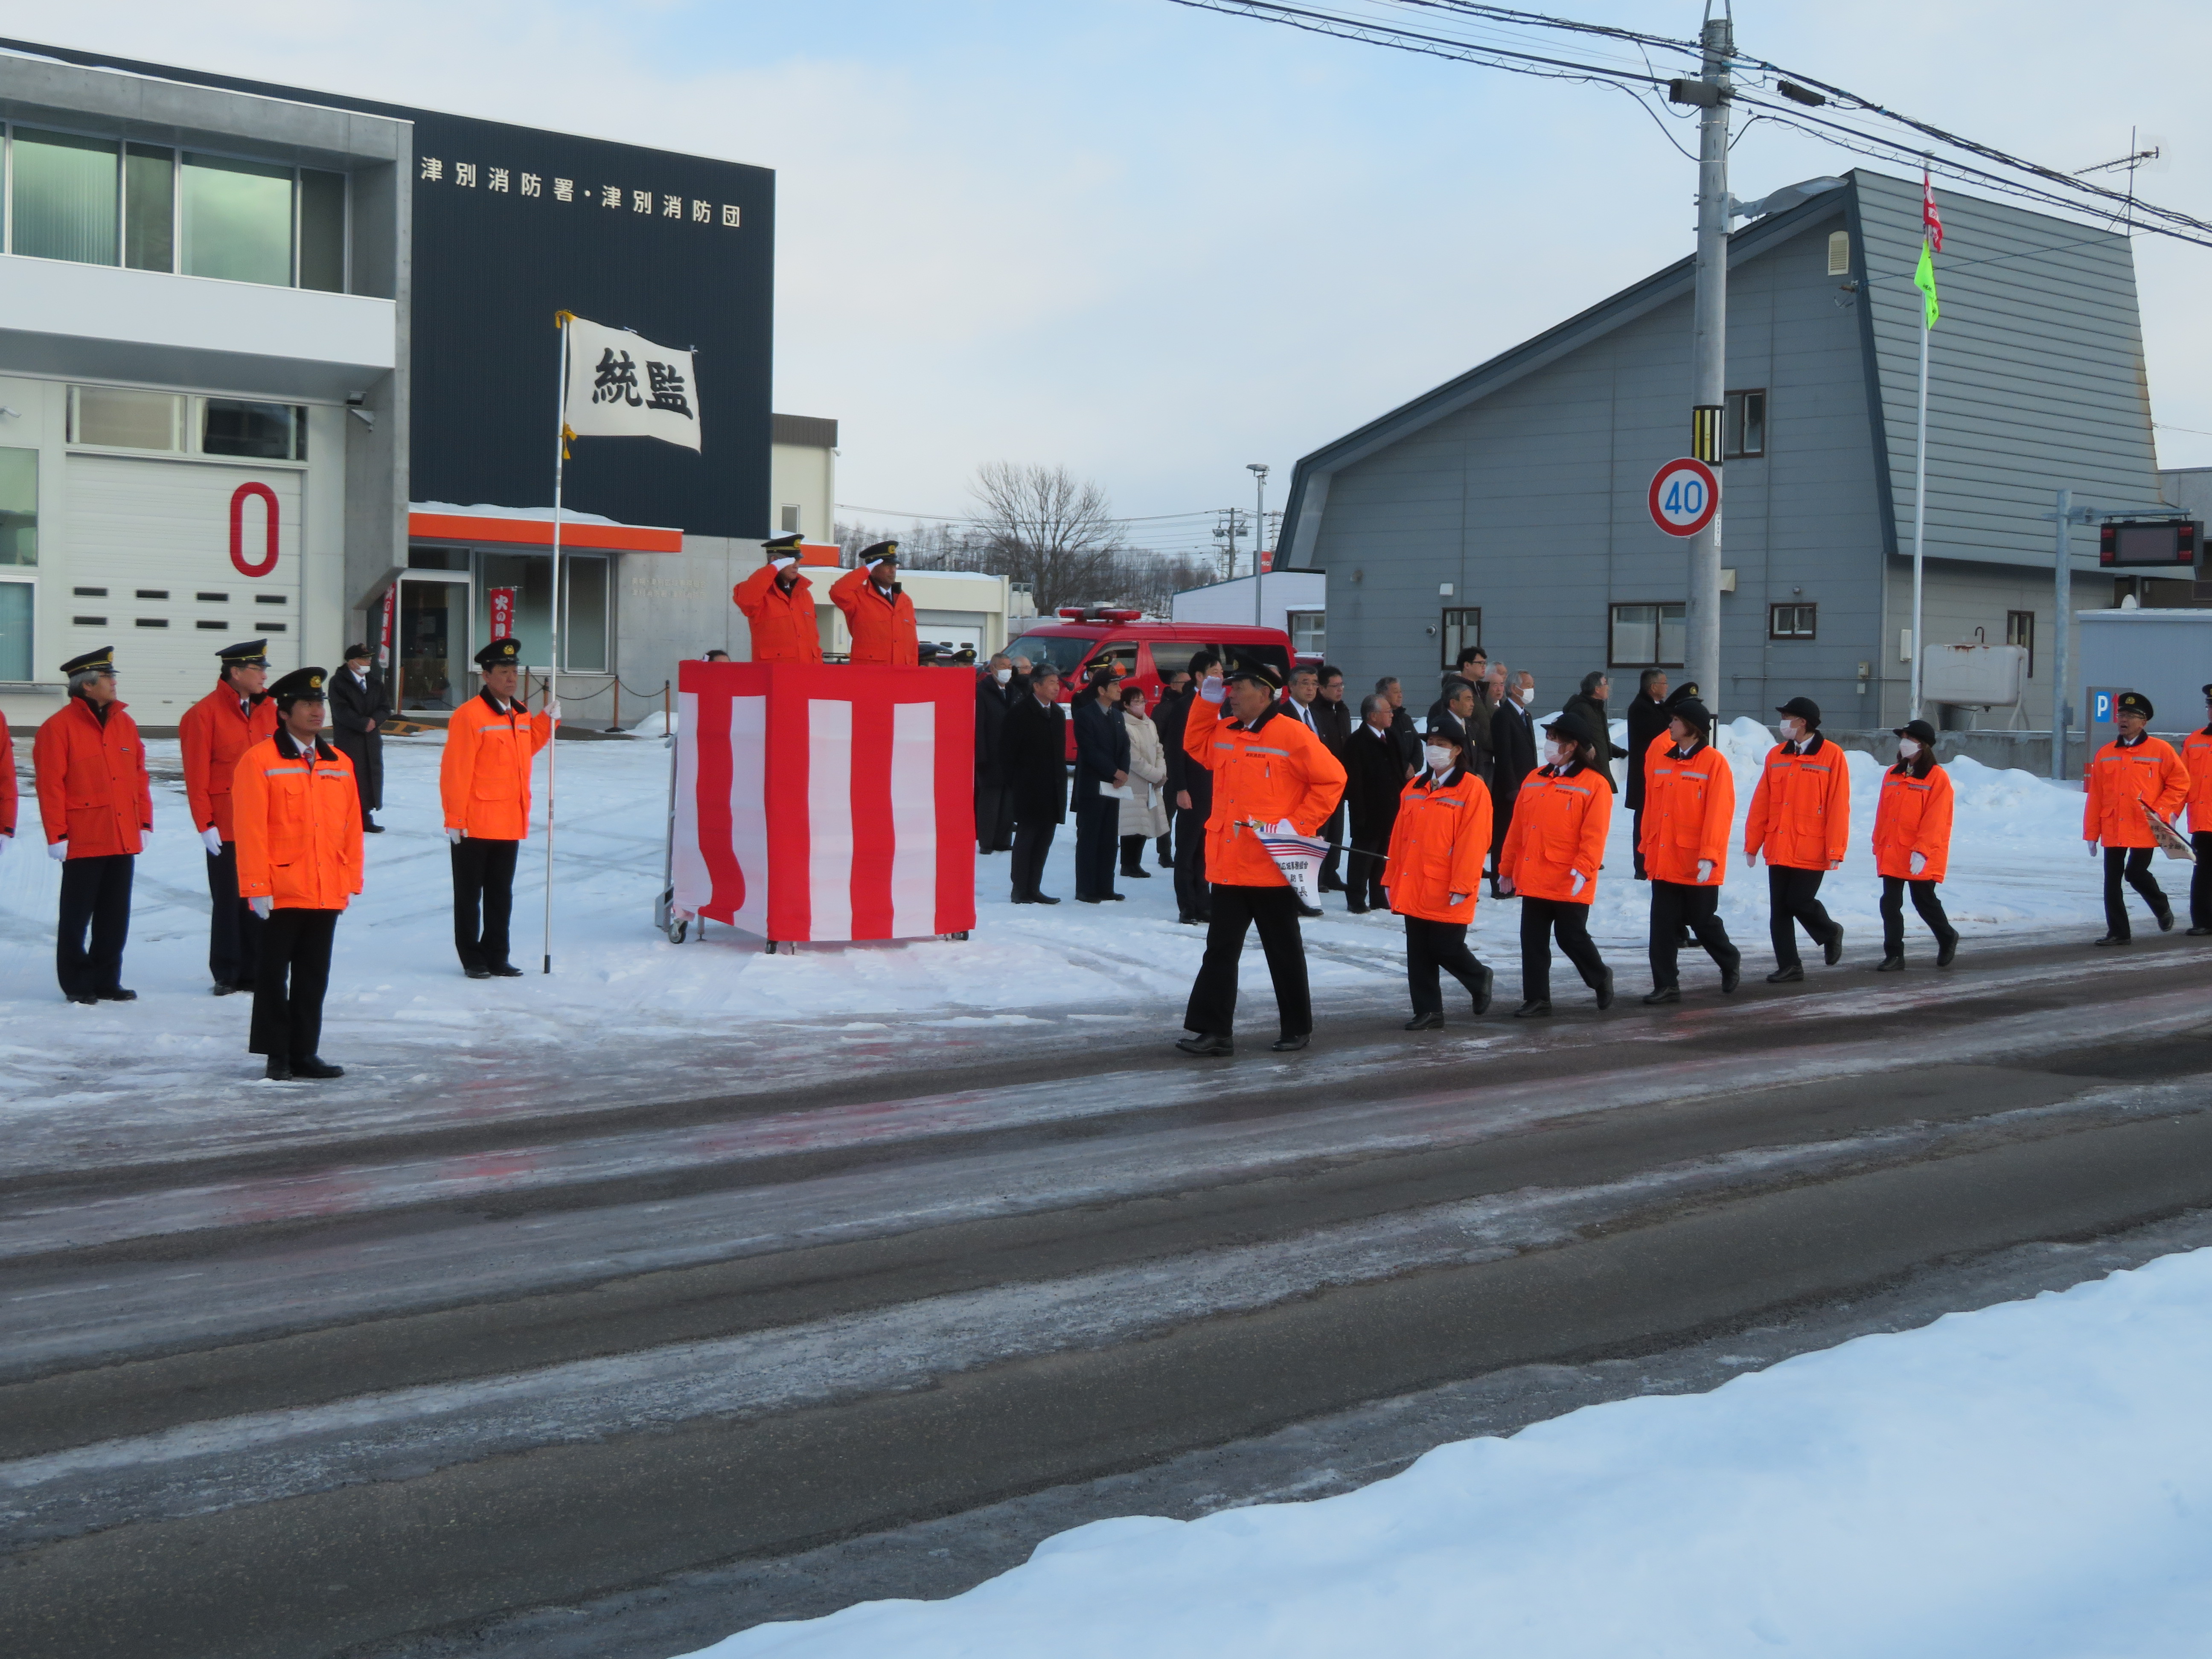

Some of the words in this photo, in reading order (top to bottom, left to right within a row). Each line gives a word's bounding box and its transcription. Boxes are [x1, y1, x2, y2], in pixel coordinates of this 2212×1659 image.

[420, 156, 740, 227] 津別消防署・津別消防団
[592, 347, 694, 420] 統監
[1665, 480, 1702, 515] 40
[495, 594, 509, 640] 火の用
[2097, 695, 2108, 717] P
